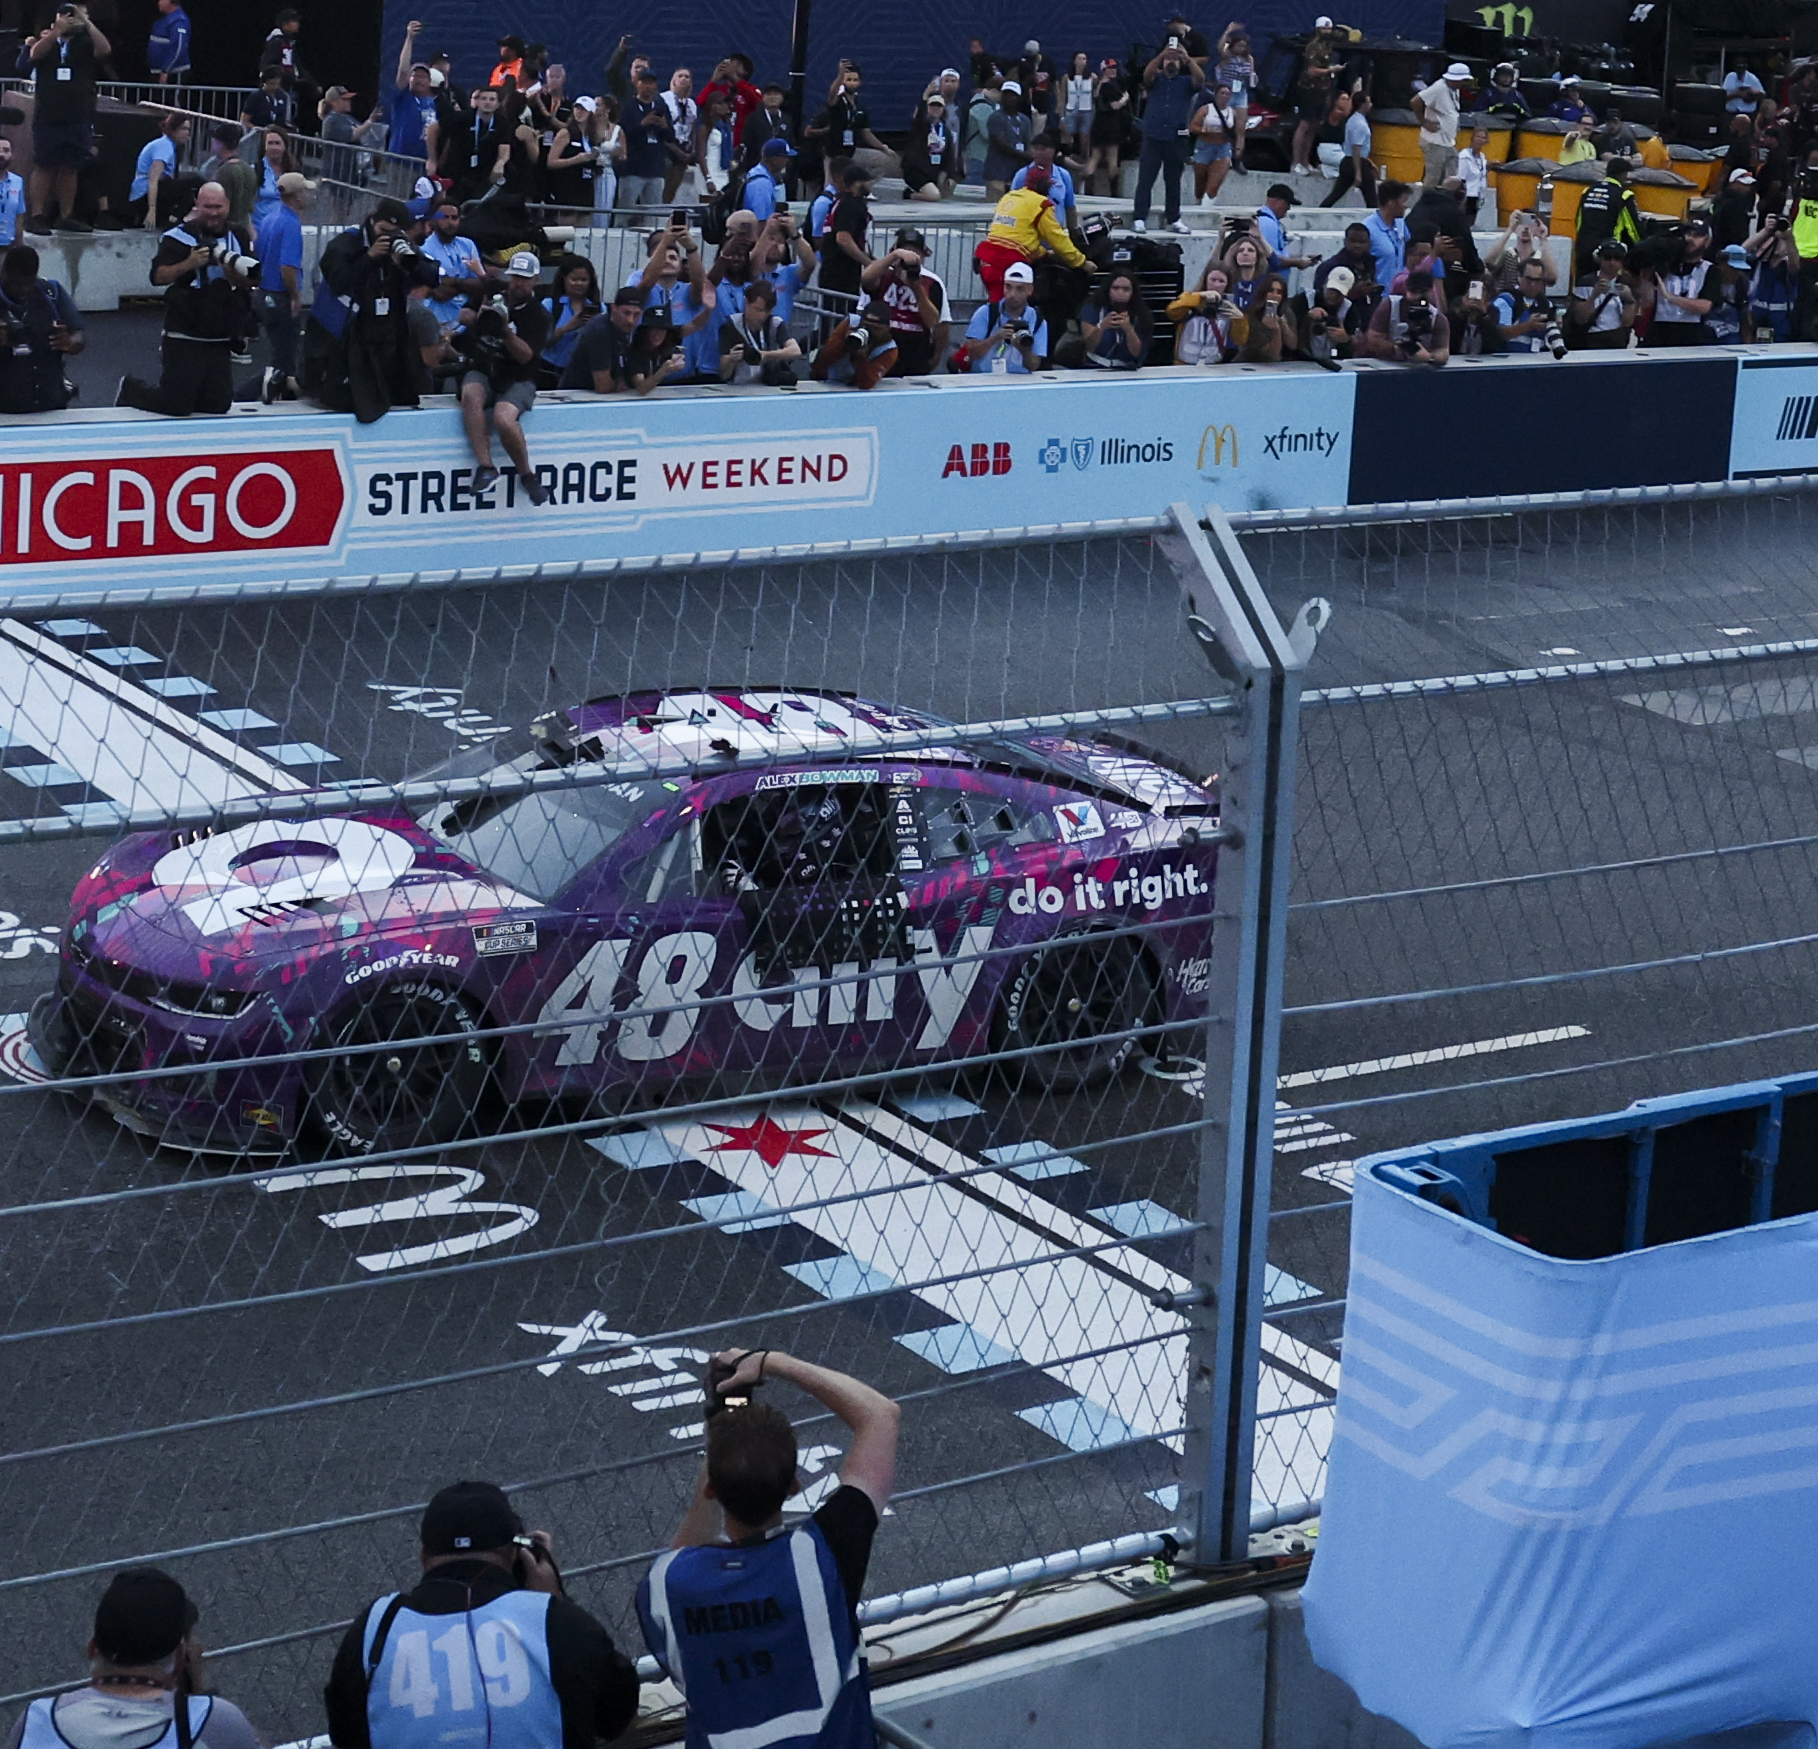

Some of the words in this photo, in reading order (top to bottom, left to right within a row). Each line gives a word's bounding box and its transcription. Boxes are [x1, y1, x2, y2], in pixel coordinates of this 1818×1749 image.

[941, 442, 1012, 479] ABB
[1099, 436, 1174, 467] Illinois
[1262, 426, 1340, 459] xfinity
[535, 459, 638, 507] RACE
[661, 453, 849, 492] WEEKEND
[754, 772, 800, 791] ALEX
[799, 769, 880, 786] BOWMAN
[1008, 878, 1064, 915] do
[1073, 872, 1106, 911] it
[1113, 863, 1209, 910] right.
[493, 923, 527, 935] NASCAR
[344, 949, 461, 985] GOODYEAR
[532, 931, 718, 1066] 48
[323, 1110, 376, 1151] EAGLE
[684, 1596, 786, 1635] MEDIA
[388, 1618, 531, 1719] 419
[712, 1649, 774, 1683] 119
